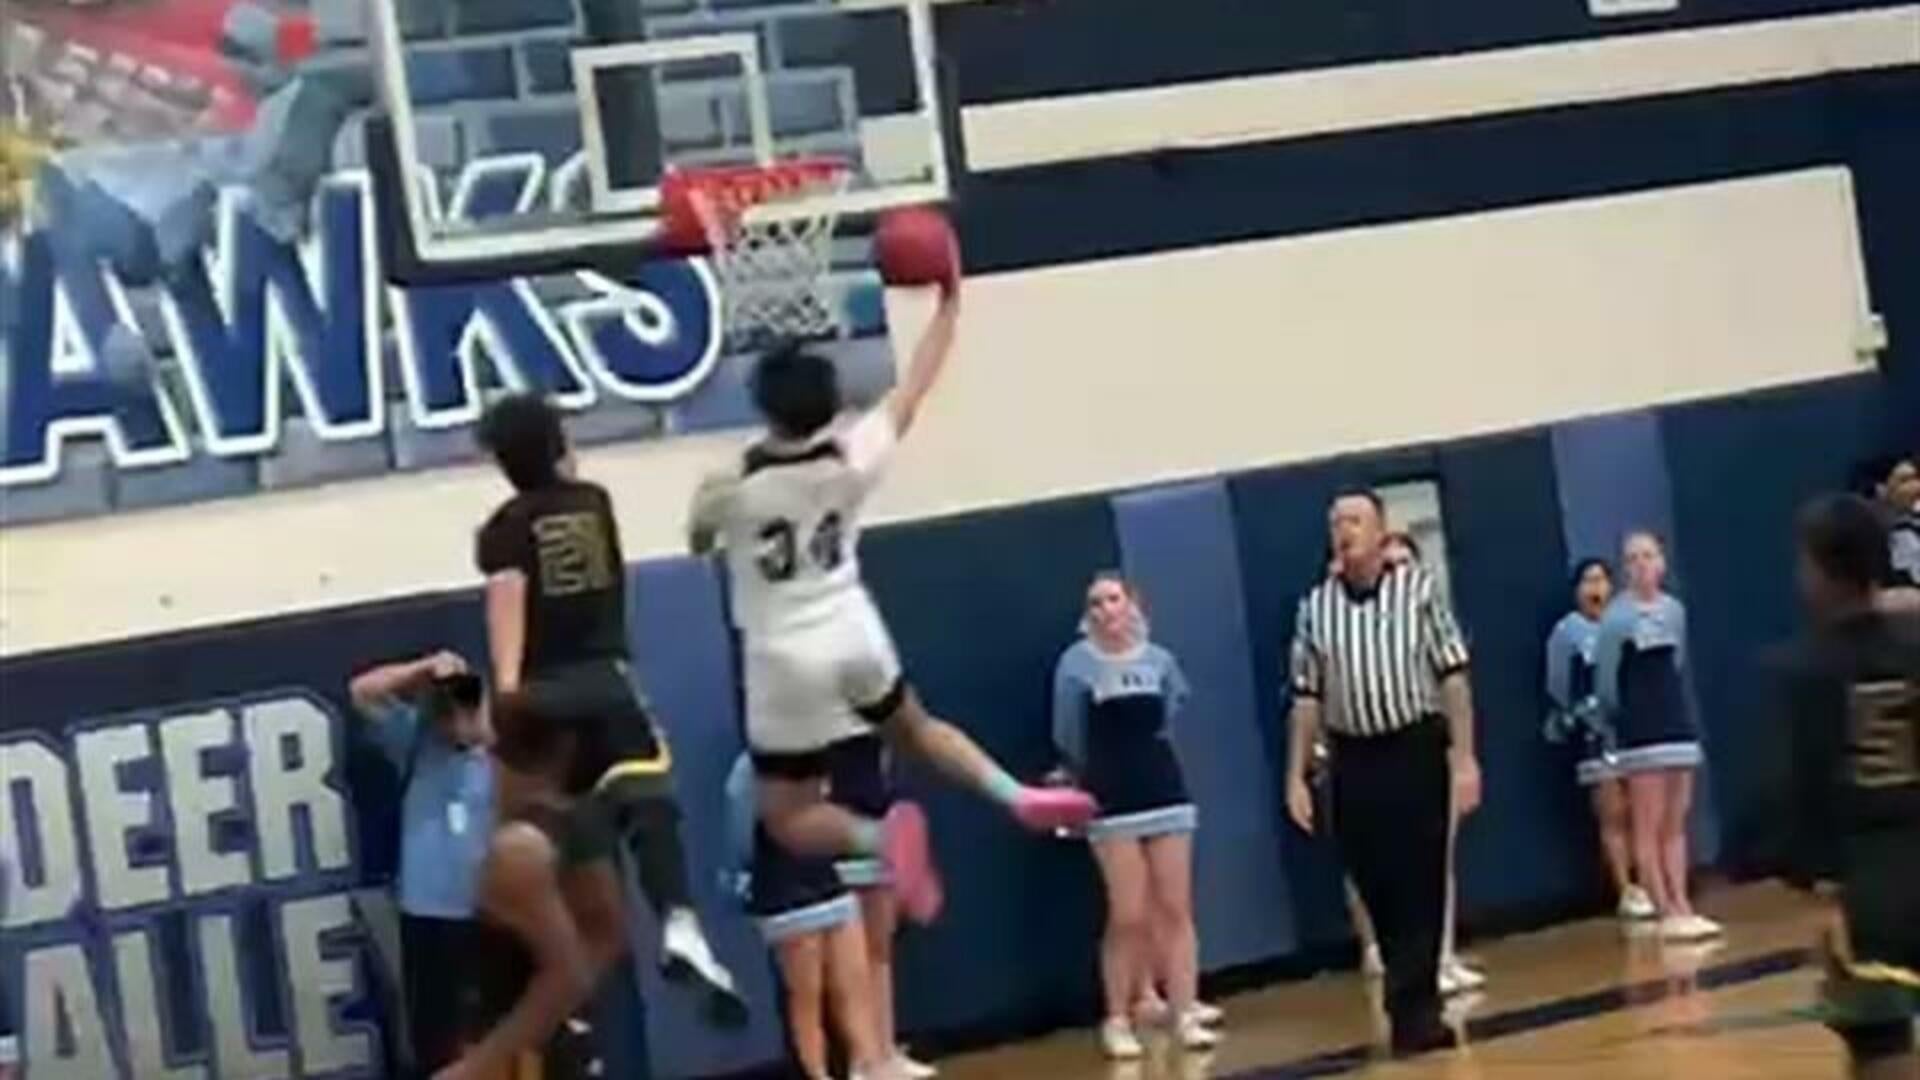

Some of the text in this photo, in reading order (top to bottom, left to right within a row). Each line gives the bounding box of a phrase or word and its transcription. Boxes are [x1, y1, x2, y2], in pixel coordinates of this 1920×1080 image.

[756, 510, 843, 583] 34
[0, 697, 352, 928] DEER
[23, 890, 402, 1080] ALLE
